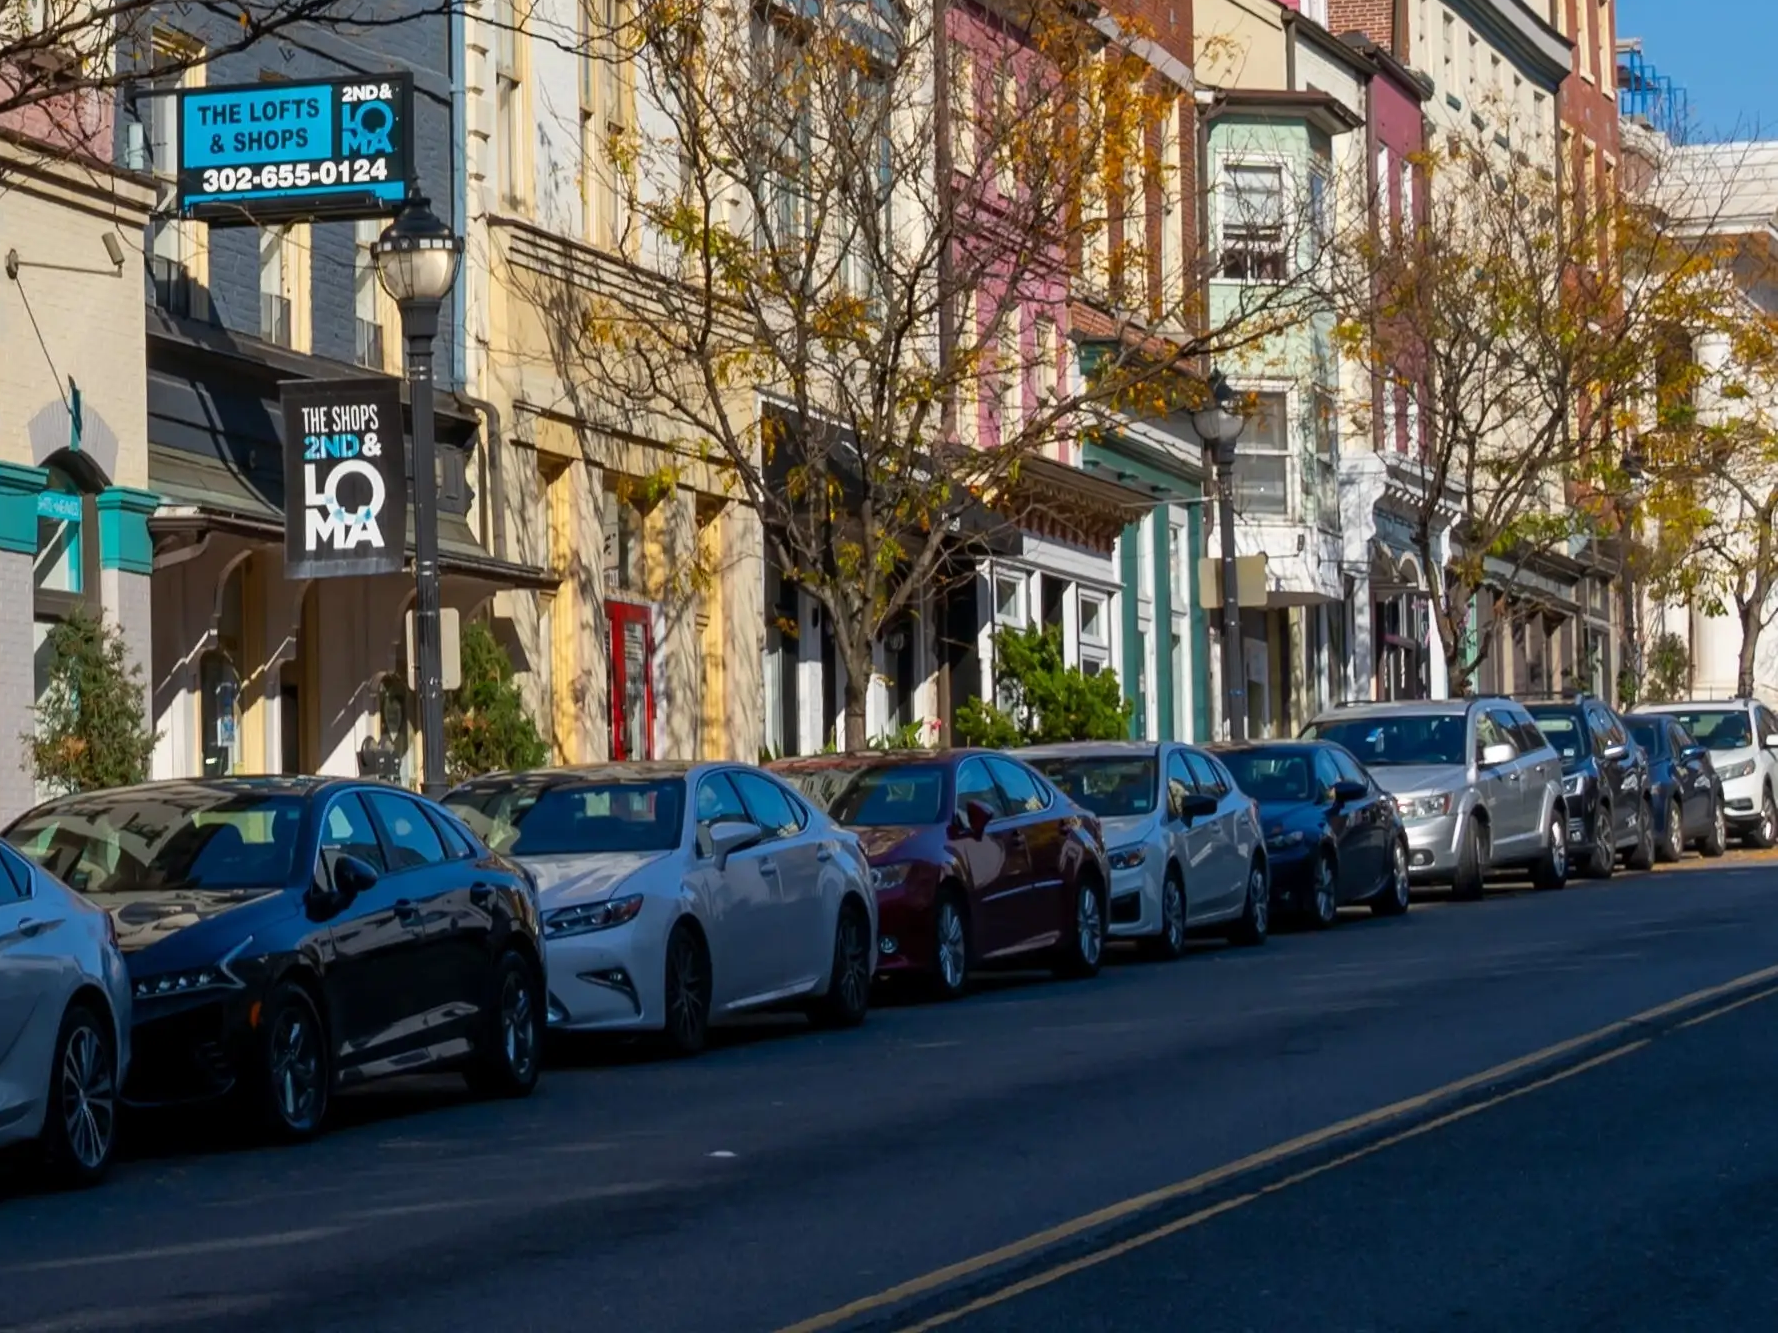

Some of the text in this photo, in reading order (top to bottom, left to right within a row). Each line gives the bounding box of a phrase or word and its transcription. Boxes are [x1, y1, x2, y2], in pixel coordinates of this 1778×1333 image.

[342, 83, 393, 102] 2ND &
[197, 97, 320, 126] THE LOFTS
[210, 128, 309, 154] & SHOPS
[202, 157, 388, 192] 302-655-0124
[302, 404, 379, 434] THE SHOPS
[303, 432, 382, 460] 2ND &
